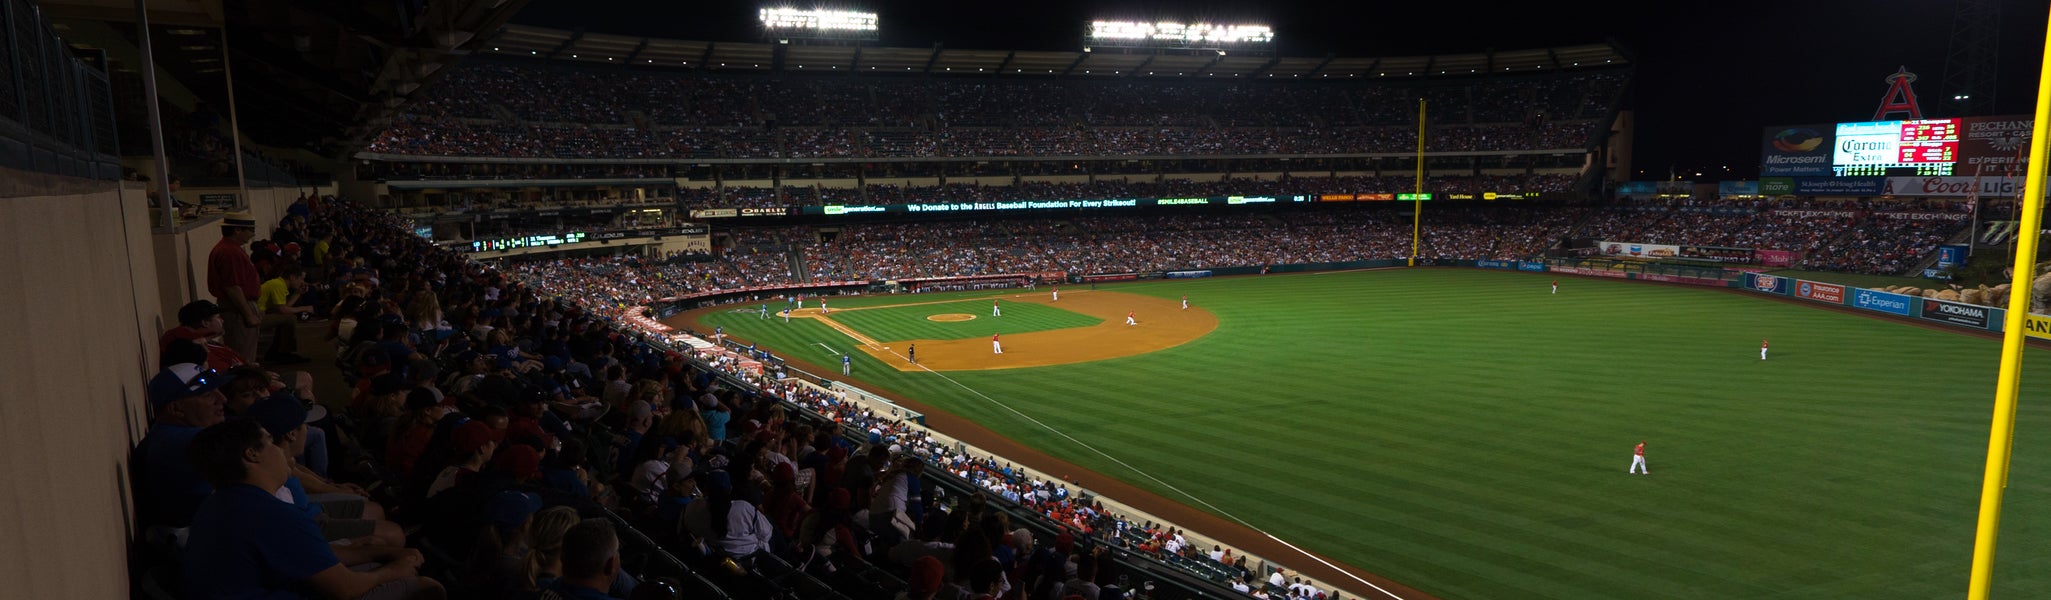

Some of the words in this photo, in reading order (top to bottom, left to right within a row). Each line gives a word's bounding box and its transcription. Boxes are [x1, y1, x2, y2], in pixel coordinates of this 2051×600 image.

[1872, 66, 1923, 120] A
[1970, 121, 2034, 130] PECHAN
[1766, 154, 1825, 164] Microsemi
[1923, 177, 1978, 193] Coor
[1028, 201, 1068, 209] Foundation
[1083, 200, 1102, 208] Every
[1103, 199, 1136, 207] Strikeout!
[1806, 210, 1855, 218] EXCHNGE
[1911, 212, 1969, 221] EXCHNGE
[1812, 283, 1840, 294] Insurance
[1812, 291, 1840, 302] AAA.com
[1871, 295, 1905, 310] Experian
[1939, 303, 1984, 318] YOKOHAMA
